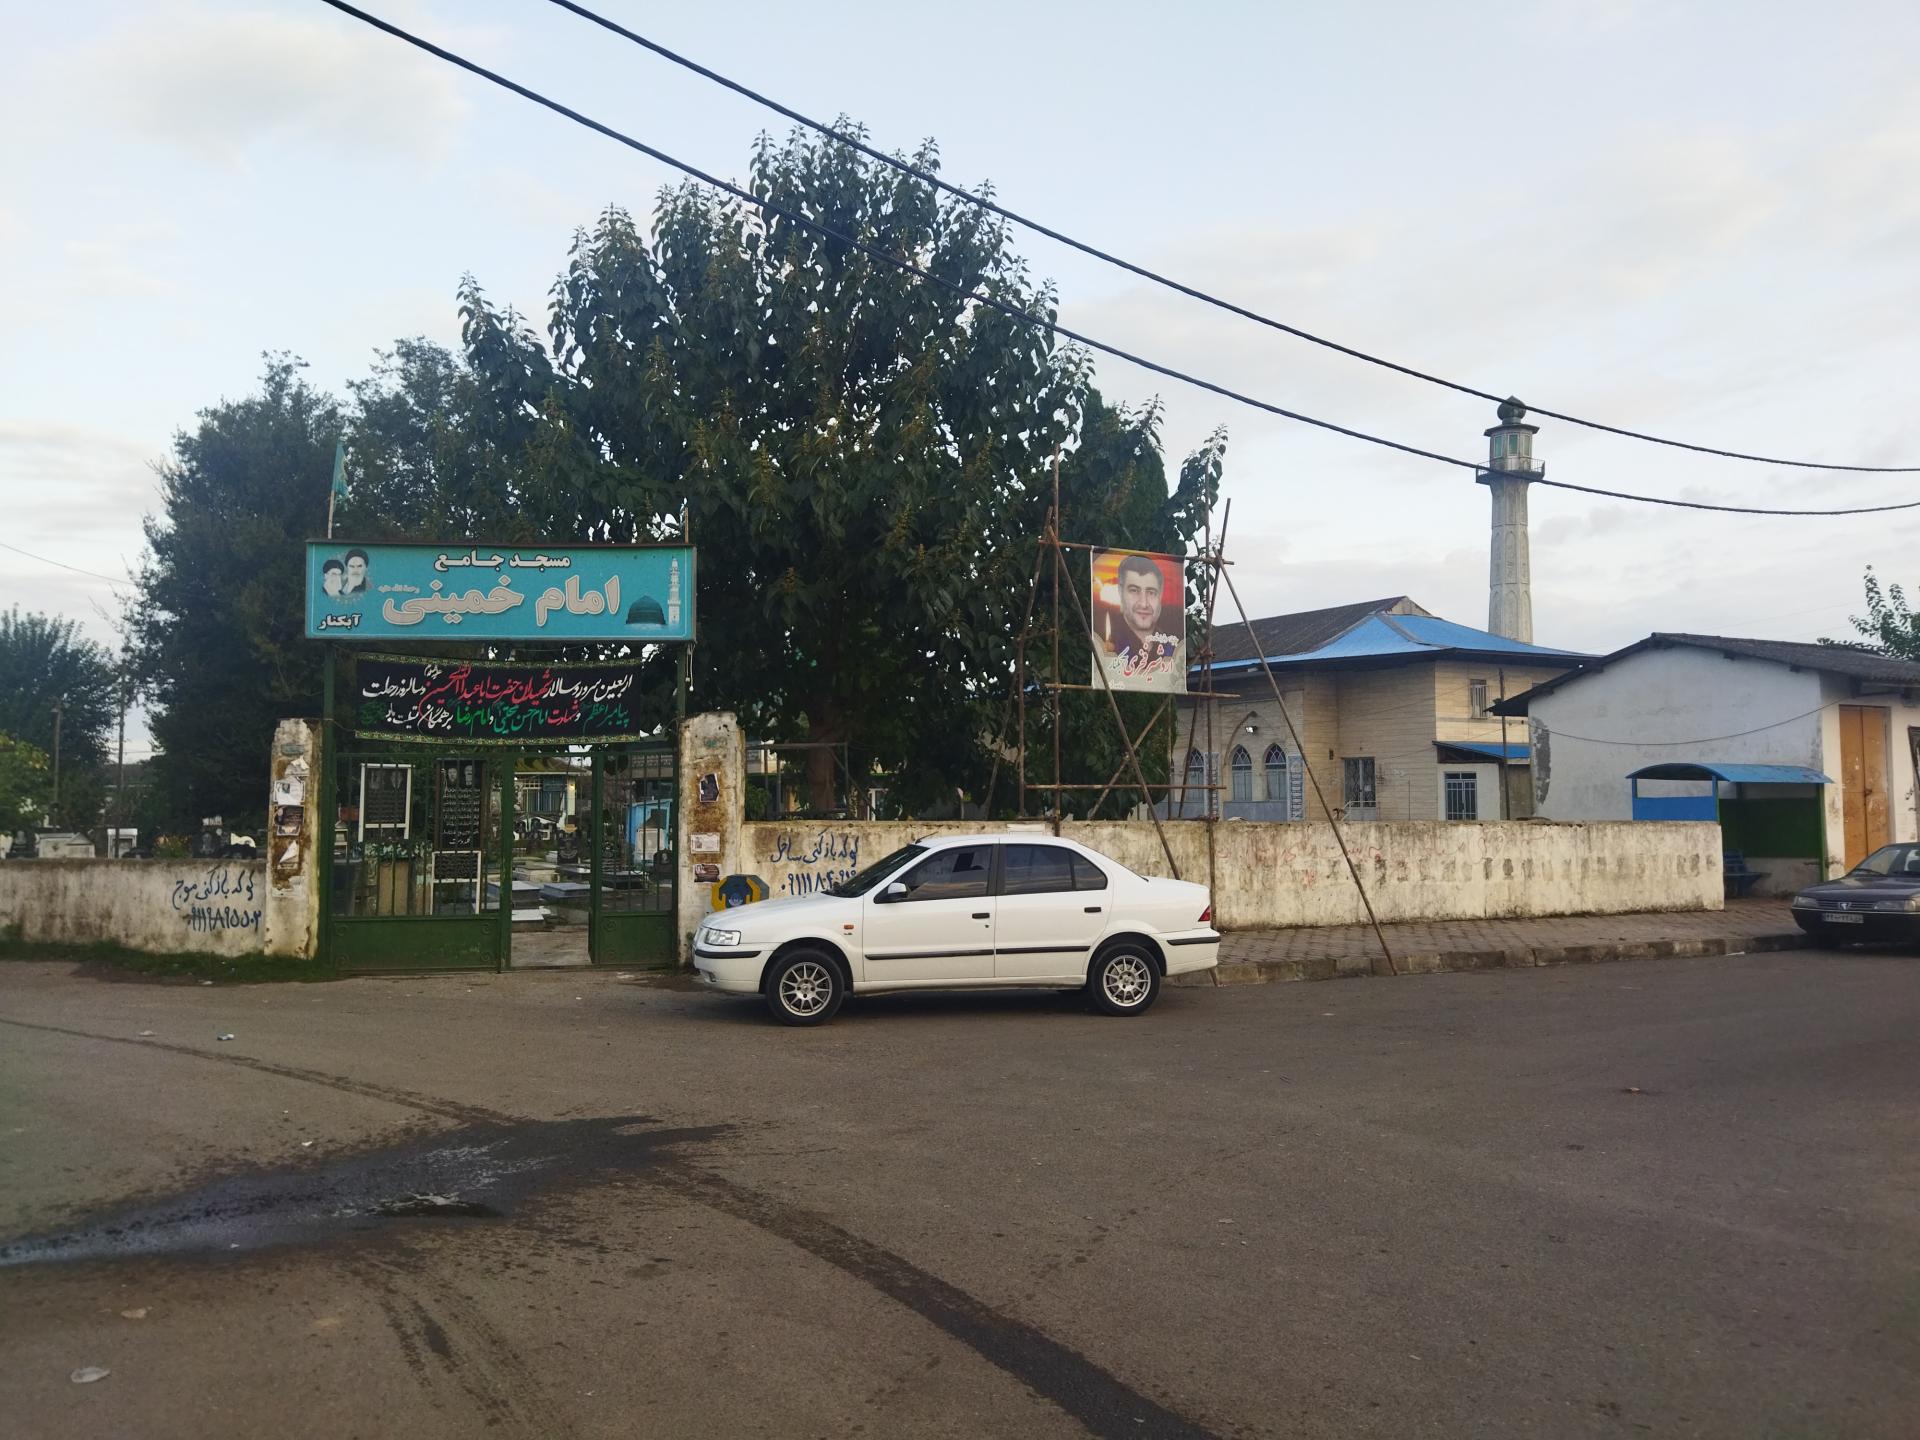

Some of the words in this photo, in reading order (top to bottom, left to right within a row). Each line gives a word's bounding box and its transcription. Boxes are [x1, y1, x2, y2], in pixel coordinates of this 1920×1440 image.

[434, 549, 504, 573] جامع
[508, 549, 571, 573] مسجد
[382, 574, 525, 626] خمینی
[535, 574, 620, 627] امام
[317, 613, 361, 630] آبکنار
[362, 676, 399, 698] رحلت
[487, 680, 521, 704] حضرت
[511, 667, 553, 705] شهیدان
[542, 677, 581, 698] سالار
[575, 679, 601, 701] سرور
[594, 674, 633, 702] اربعین
[417, 704, 450, 734] همگان
[441, 714, 454, 730] بر
[456, 706, 471, 725] رضا
[511, 708, 534, 731] حسن
[547, 700, 580, 725] شهادت
[583, 703, 608, 733] اعظم
[597, 703, 629, 727] پیامبر
[770, 834, 802, 863] ساحل
[172, 880, 197, 910] موج
